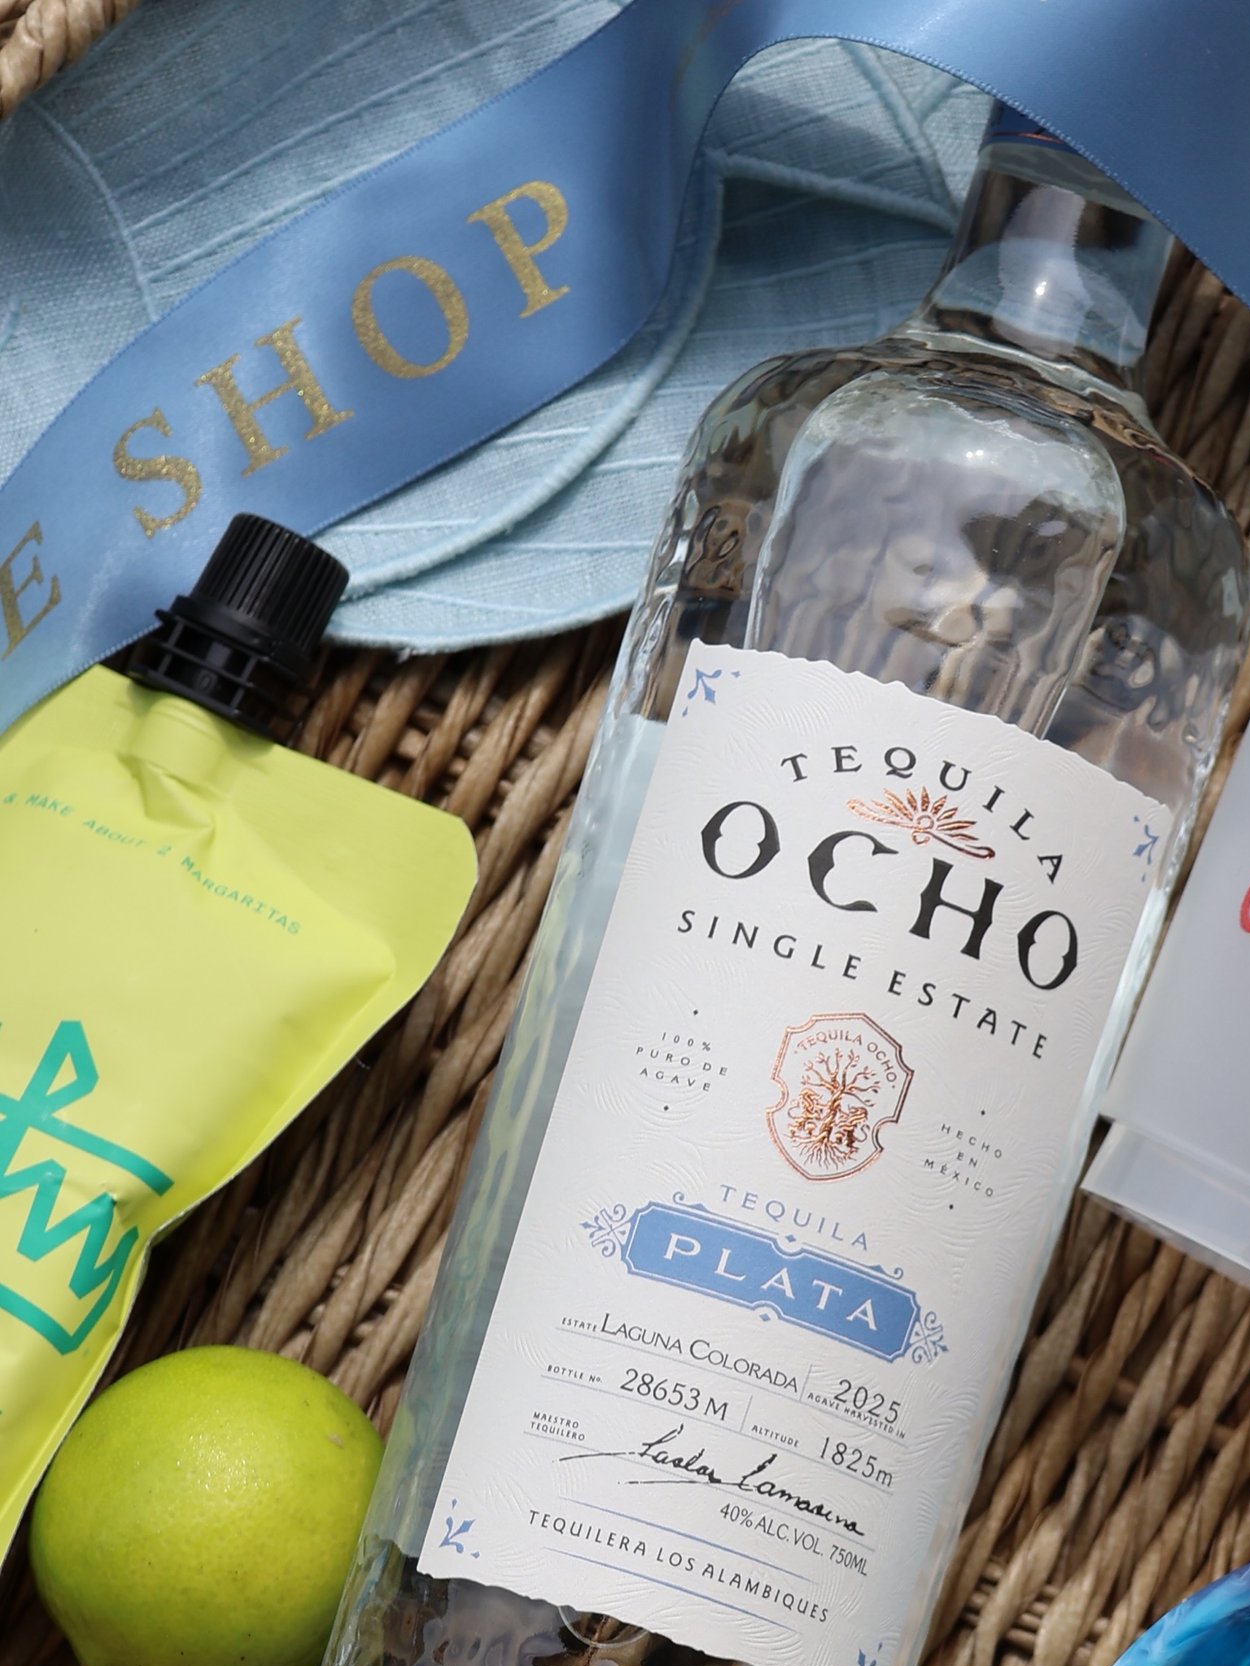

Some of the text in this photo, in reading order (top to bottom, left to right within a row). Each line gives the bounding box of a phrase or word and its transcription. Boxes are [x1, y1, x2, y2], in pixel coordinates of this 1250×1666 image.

[113, 180, 571, 539] SHOP
[780, 745, 1064, 885] TEQUILA
[24, 793, 75, 816] MAKE
[82, 819, 146, 848] ABOUT
[181, 855, 301, 935] MARGARITAS
[700, 800, 1079, 991] OCHO
[677, 909, 1049, 1060] SINGLE ESTATE
[636, 1046, 728, 1076] PURO DE
[661, 1031, 711, 1052] 100%
[797, 1029, 863, 1051] TEQUILA
[640, 1067, 711, 1092] AGAVE
[941, 1123, 1002, 1159] HECHO
[956, 1152, 978, 1168] EN
[924, 1159, 994, 1197] MÉXICO
[719, 1183, 869, 1252] TEQUILA
[662, 1232, 879, 1331] PLATA
[561, 1317, 598, 1332] ESTATE
[547, 1364, 584, 1380] BOTTLE
[533, 1411, 579, 1429] MAESTRO
[807, 1392, 840, 1410] AGAVE
[844, 1406, 894, 1434] HARVESTED
[834, 1379, 901, 1424] 2025
[530, 1422, 585, 1441] TEQUILERO
[752, 1425, 893, 1488] ALTITUDE 1825m
[720, 1503, 753, 1528] 40%
[829, 1544, 868, 1576] 750ML
[528, 1509, 829, 1624] TEQUILERA LOS ALAMBIQUES
